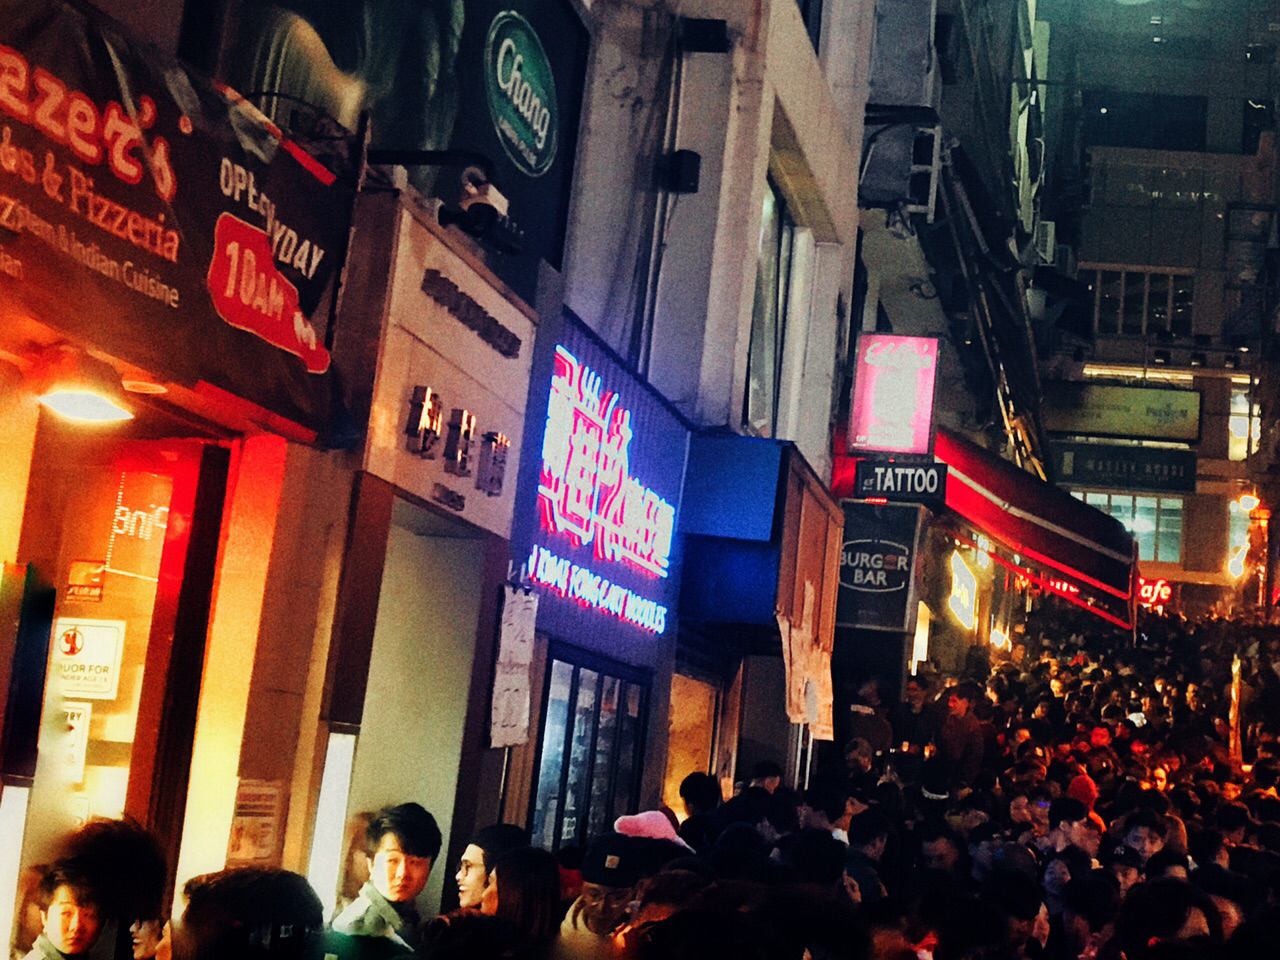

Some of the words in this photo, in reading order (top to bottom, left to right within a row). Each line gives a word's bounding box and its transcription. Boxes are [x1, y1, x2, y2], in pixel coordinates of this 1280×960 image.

[497, 38, 550, 149] Chang
[68, 165, 179, 264] Pizzeria
[122, 260, 179, 308] Cuisine
[874, 466, 939, 493] TATTOO
[853, 569, 888, 586] BAR
[88, 664, 110, 675] FOR
